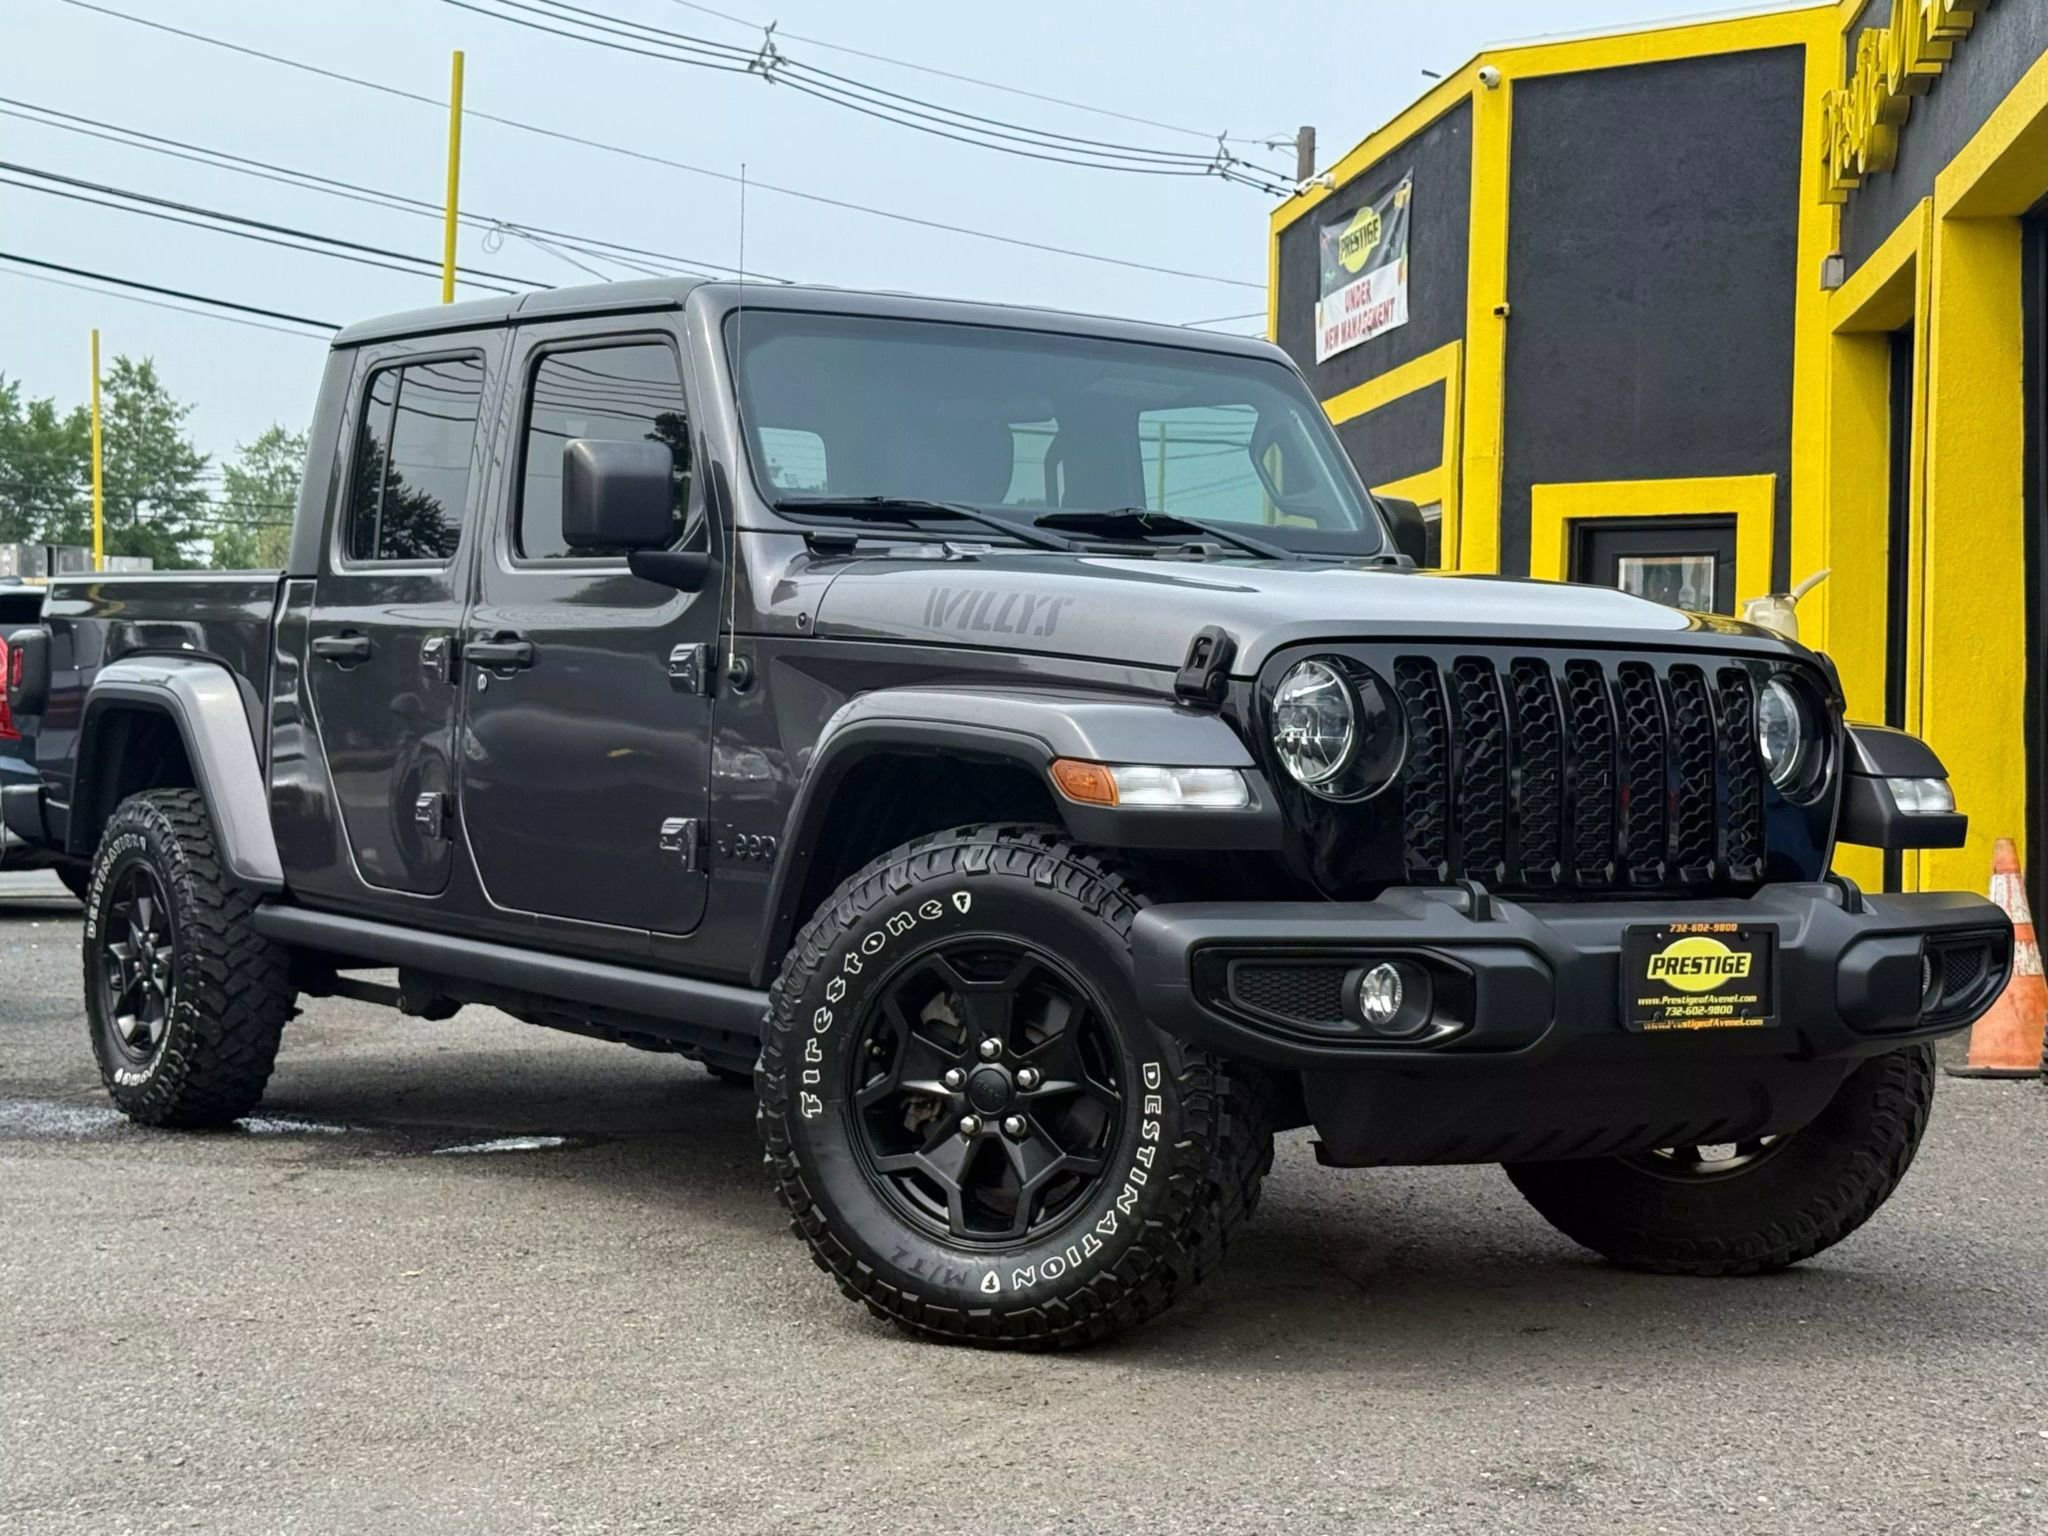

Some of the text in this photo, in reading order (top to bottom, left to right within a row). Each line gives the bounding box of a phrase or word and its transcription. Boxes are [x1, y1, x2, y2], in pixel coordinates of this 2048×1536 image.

[1341, 219, 1379, 260] PRESTIGE
[1345, 280, 1372, 312] UNDER
[1323, 298, 1396, 351] NEW MANAGEMENT
[923, 587, 1075, 636] WILLYS
[717, 824, 777, 859] Jeep
[1669, 923, 1738, 933] 732-602-9800
[1651, 955, 1747, 976] PRESTIGE
[800, 900, 943, 1118] Firestone
[1665, 1005, 1733, 1016] 732-602-9800
[1012, 1062, 1161, 1290] DESTINATION
